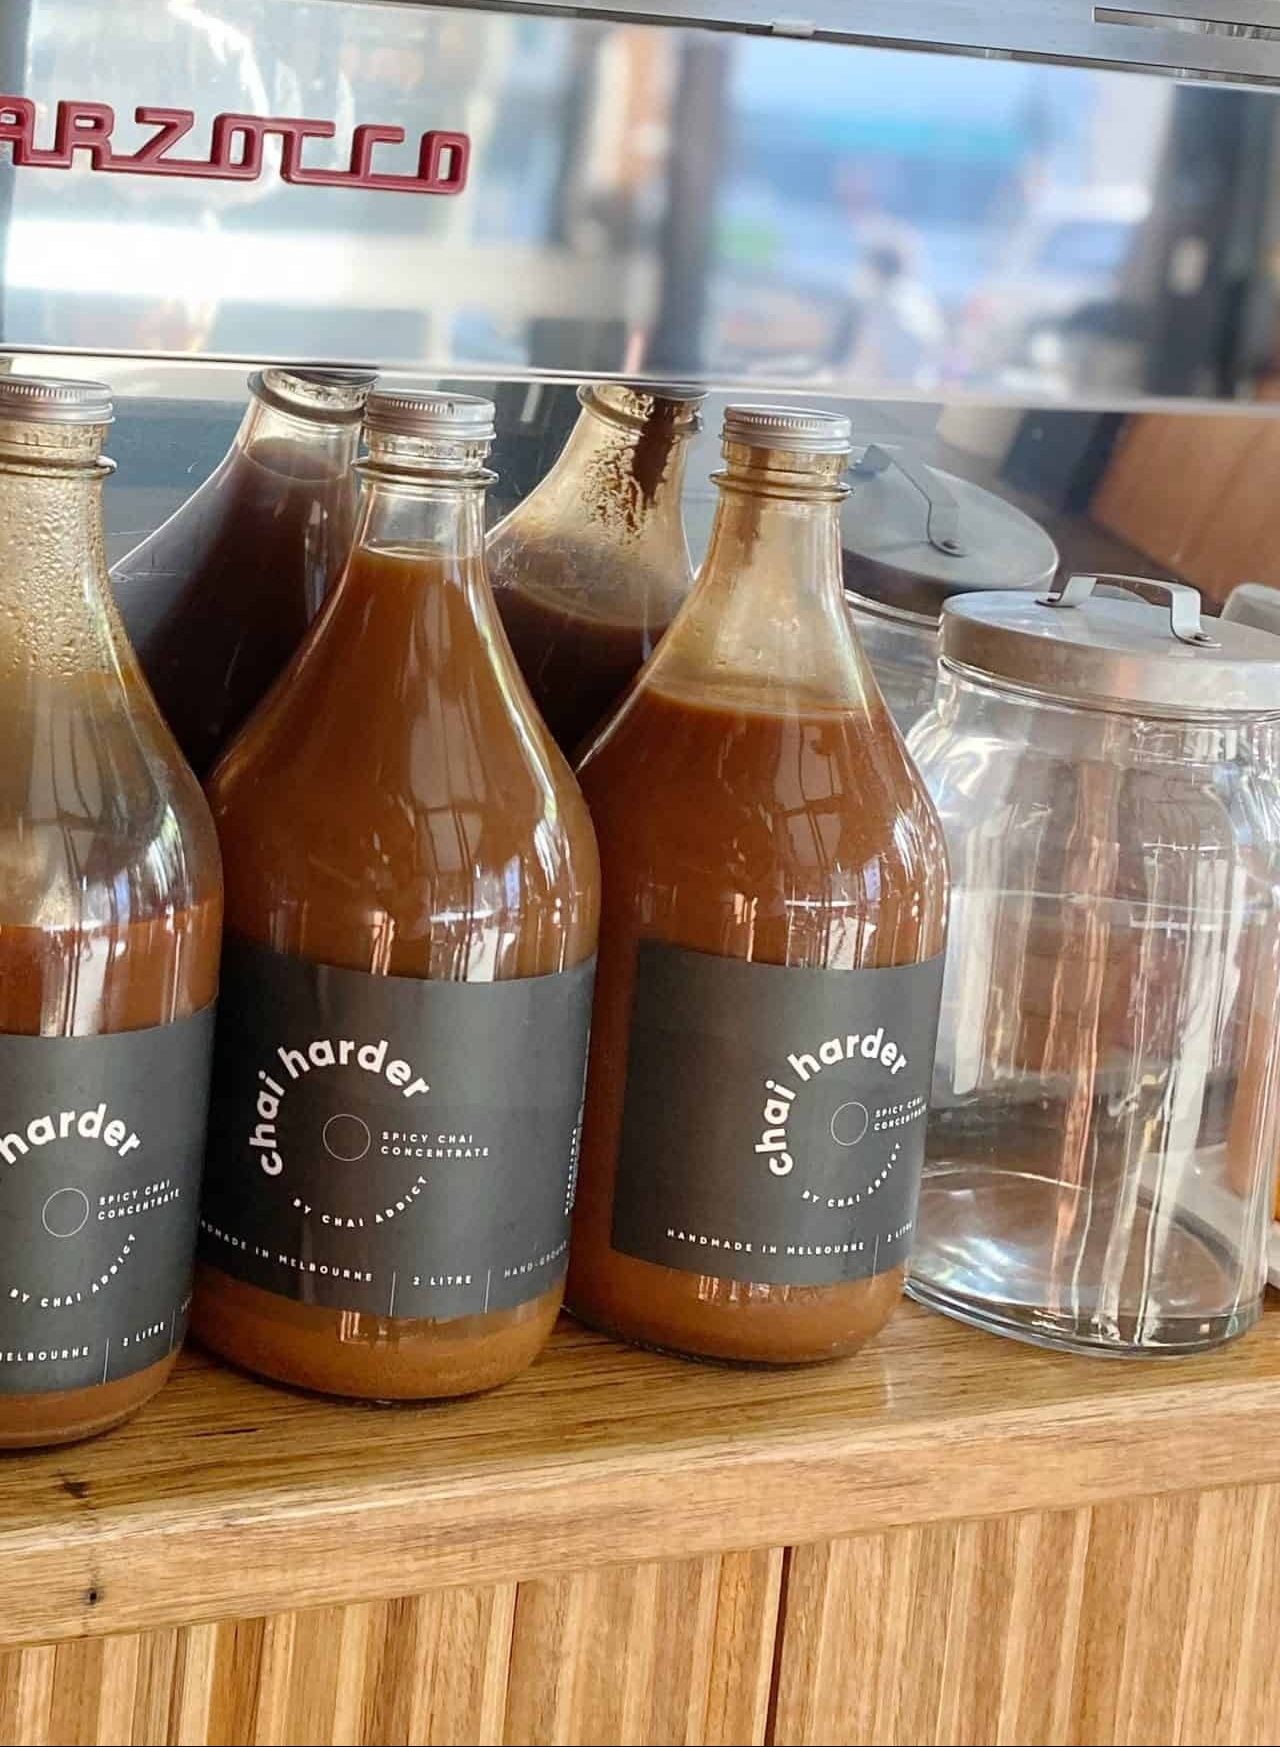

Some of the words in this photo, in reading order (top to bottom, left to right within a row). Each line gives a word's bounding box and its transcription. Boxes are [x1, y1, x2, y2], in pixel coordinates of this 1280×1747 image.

[249, 1070, 285, 1177] chai
[277, 1038, 429, 1098] harder
[754, 1079, 797, 1177] chai
[787, 1027, 908, 1082] harder
[875, 1104, 903, 1119] SPICY
[381, 1131, 429, 1144] SPICY
[438, 1133, 473, 1144] CHAI
[381, 1145, 489, 1158] CONCENTRATE
[802, 1190, 820, 1203] BY
[827, 1193, 860, 1207] CHAI
[867, 1142, 901, 1195] ADDICT
[98, 1188, 180, 1220] CONCENTRATE
[99, 1190, 138, 1206] SPICY
[145, 1179, 170, 1196] CHAI
[293, 1198, 312, 1214] BY
[322, 1214, 364, 1228] CHAI
[375, 1175, 427, 1223] ADDICT
[667, 1228, 752, 1252] HANDMADE
[762, 1245, 777, 1254] IN
[787, 1242, 864, 1256] MELBOURNE
[9, 1288, 30, 1303] BY
[40, 1292, 81, 1308] CHAI
[92, 1233, 136, 1293] ADDICT
[255, 1246, 269, 1258] IN
[279, 1255, 374, 1282] MELBOURNE
[430, 1275, 472, 1287] LITRE
[135, 1321, 165, 1342] LITRE
